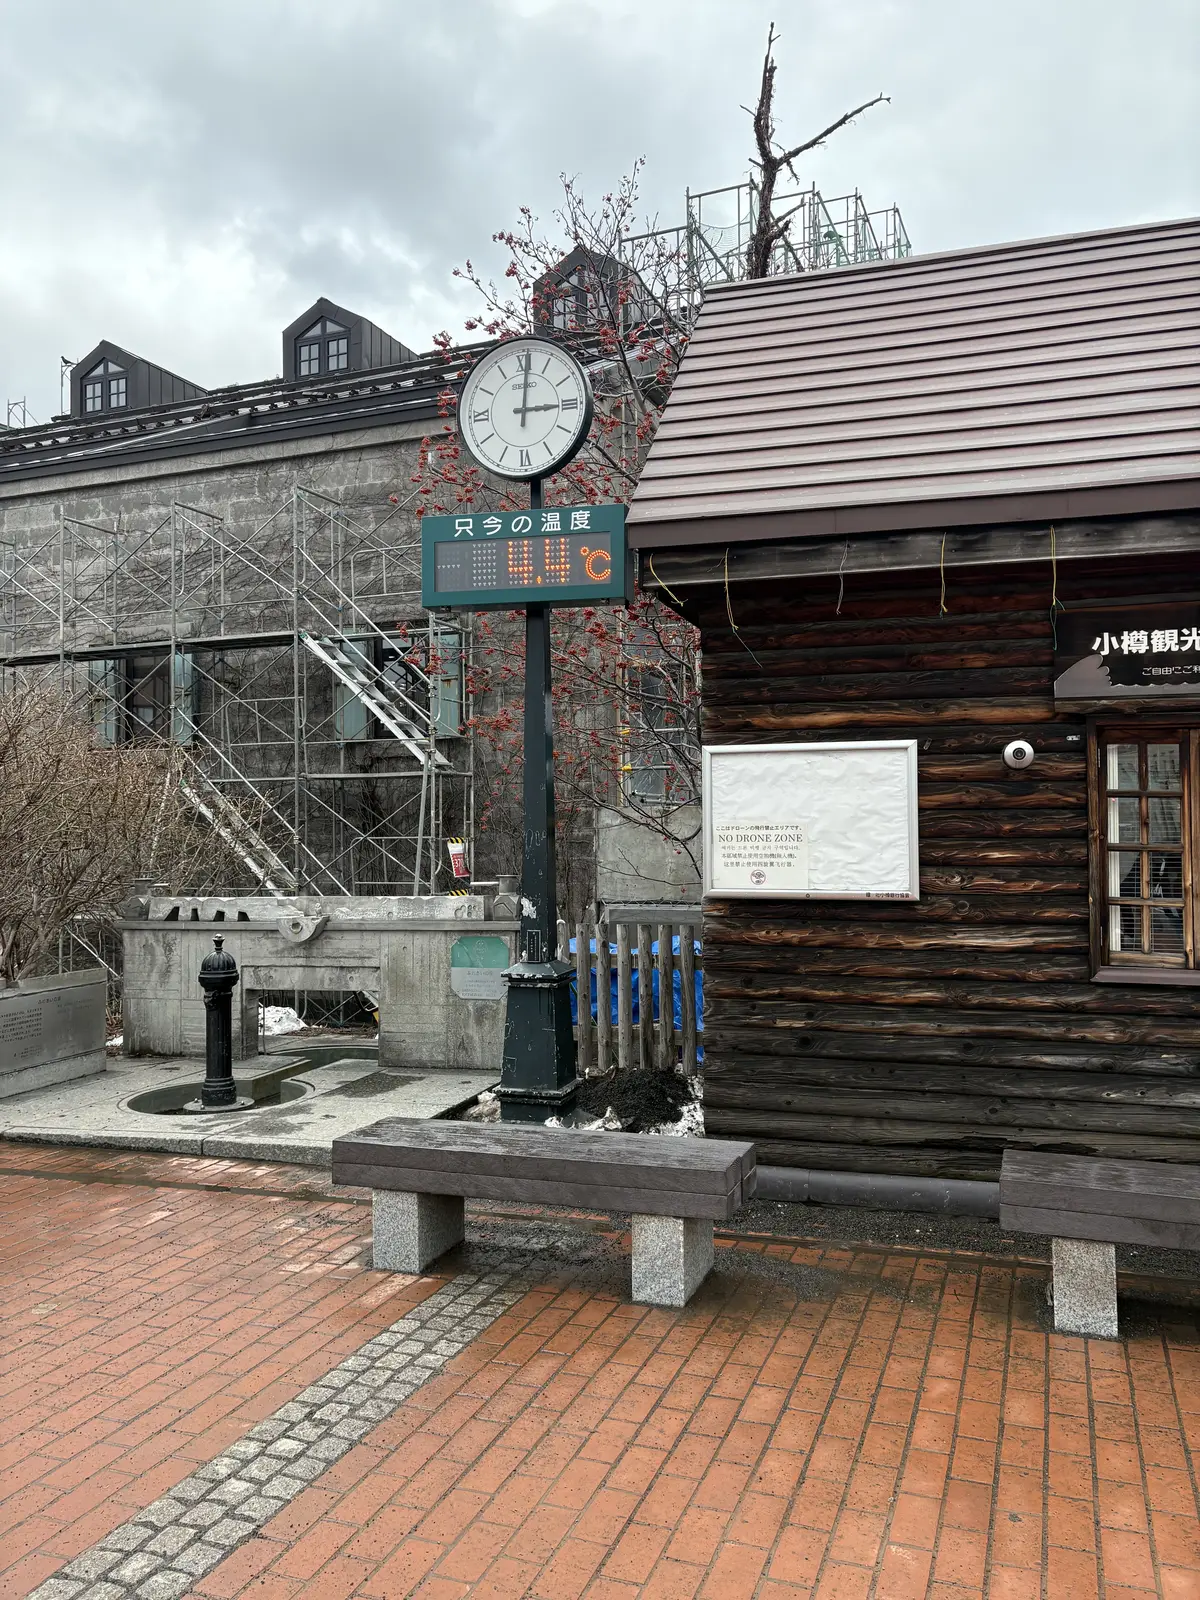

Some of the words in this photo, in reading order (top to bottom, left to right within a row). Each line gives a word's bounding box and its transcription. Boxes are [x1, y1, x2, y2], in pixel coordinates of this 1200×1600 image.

[453, 510, 592, 538] 只今の温度
[1091, 627, 1200, 656] 小樽観光
[718, 834, 733, 843] NO
[736, 834, 772, 842] DRONE
[774, 833, 803, 842] ZONE
